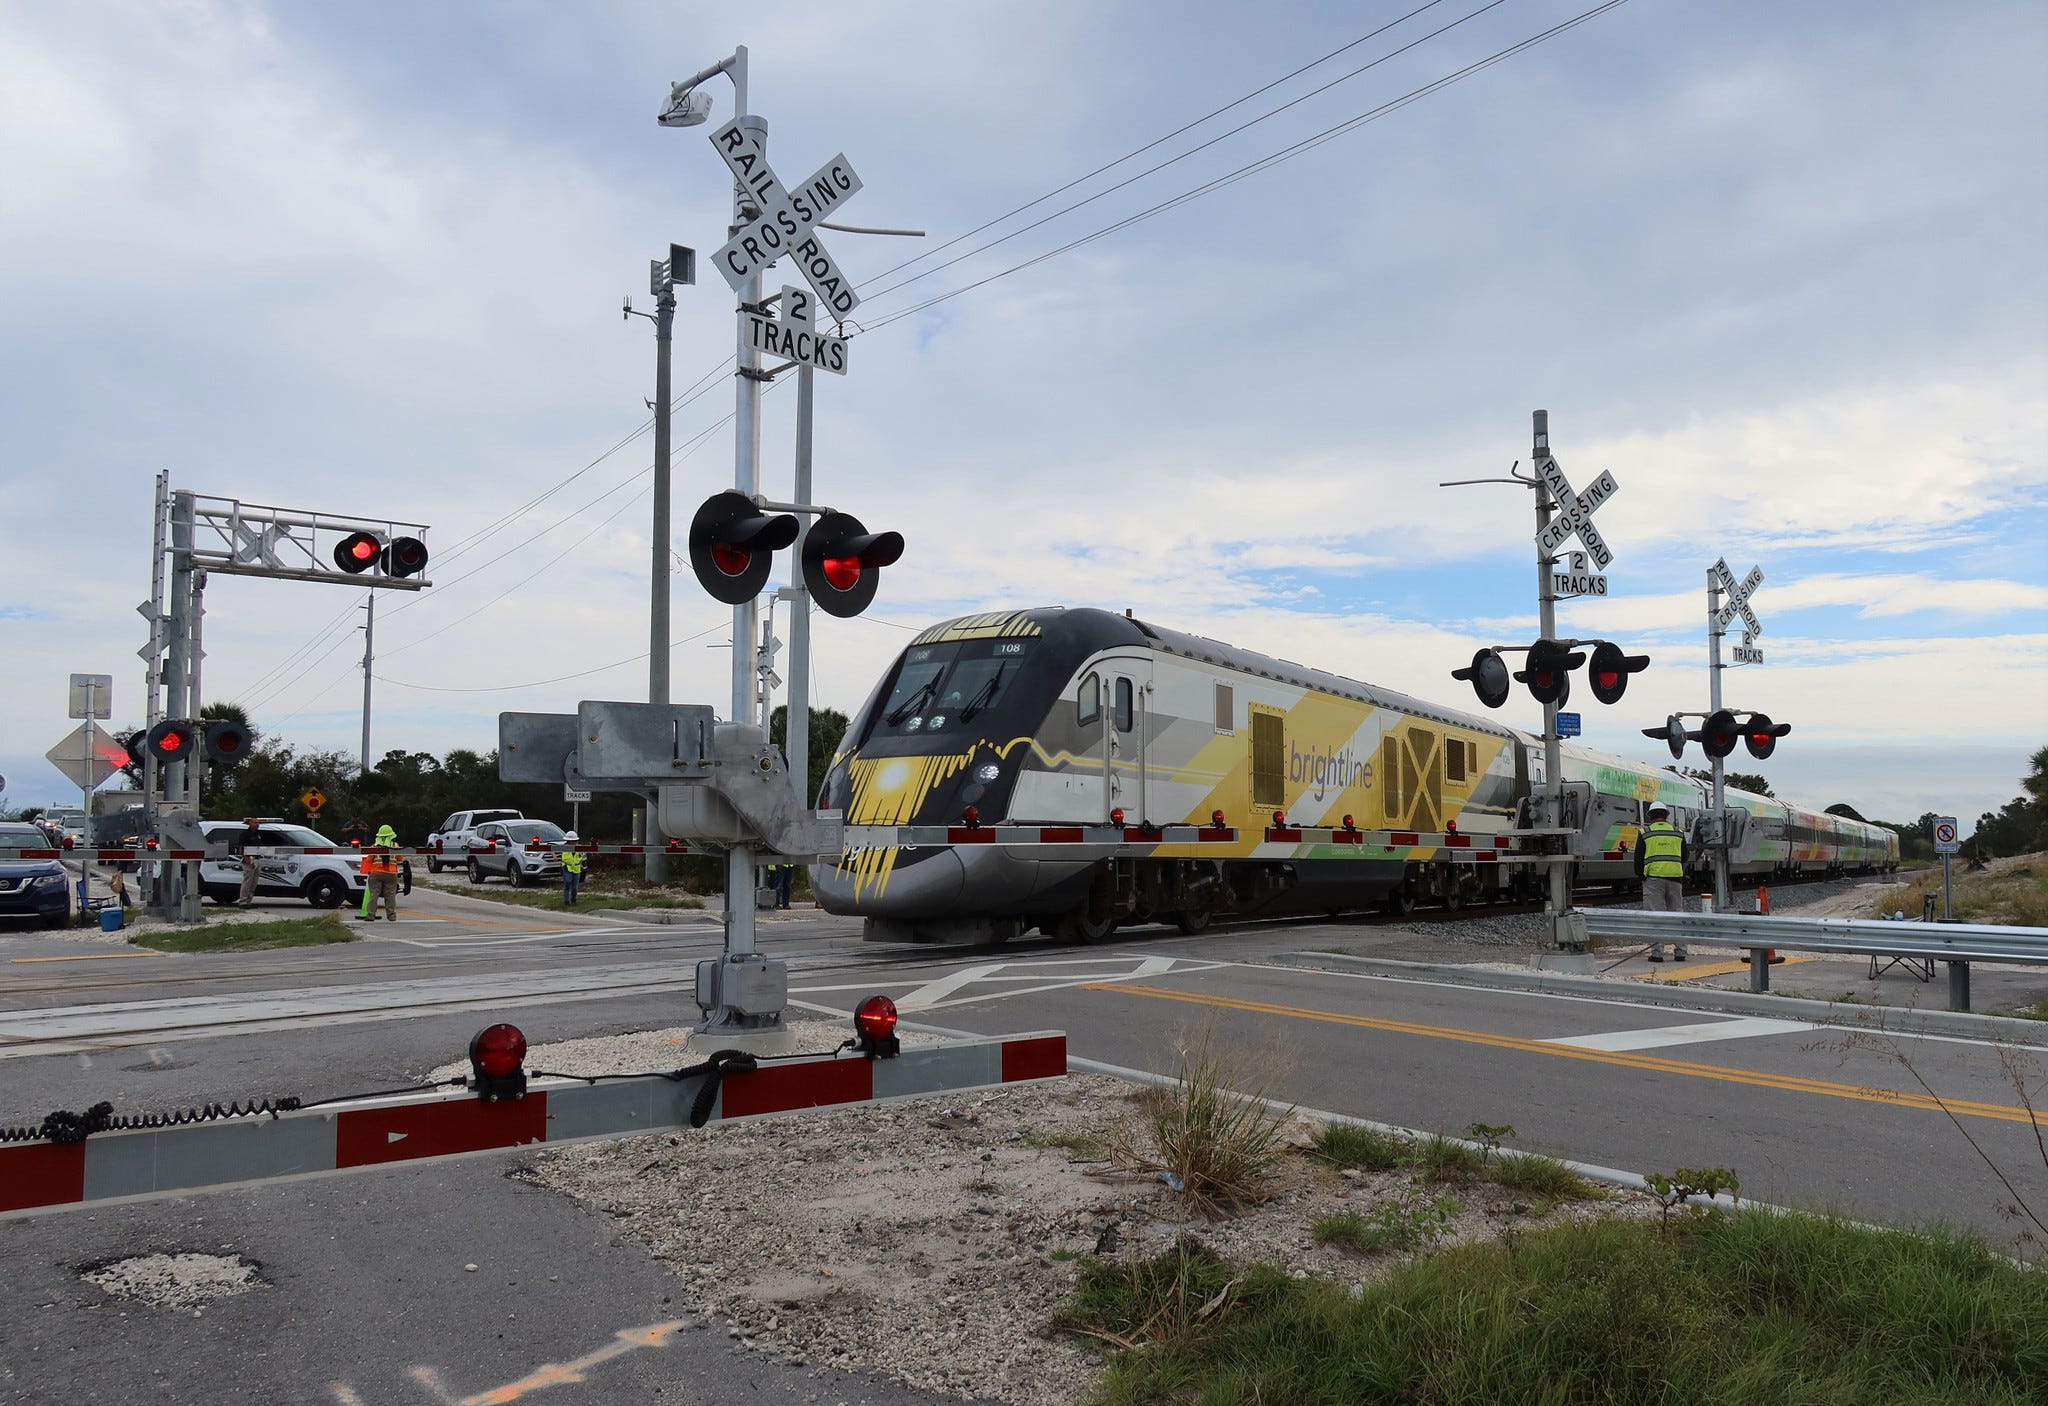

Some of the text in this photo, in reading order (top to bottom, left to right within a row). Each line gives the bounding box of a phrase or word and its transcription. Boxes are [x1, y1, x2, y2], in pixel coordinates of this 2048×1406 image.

[720, 126, 853, 314] RAIL ROAD
[727, 166, 851, 276] CROSSING
[790, 291, 807, 321] 2
[750, 317, 844, 372] TRACKS
[1542, 477, 1612, 549] CROSSING
[1542, 460, 1609, 567] RAIL ROAD
[1553, 574, 1606, 595] TRACKS
[1574, 553, 1584, 569] 2
[1716, 561, 1760, 636] RAIL ROAD
[1719, 570, 1761, 626] CROSSING
[1000, 643, 1021, 653] 108
[1733, 647, 1763, 663] TRACKS
[1744, 632, 1751, 645] 2
[1290, 740, 1373, 802] brightline
